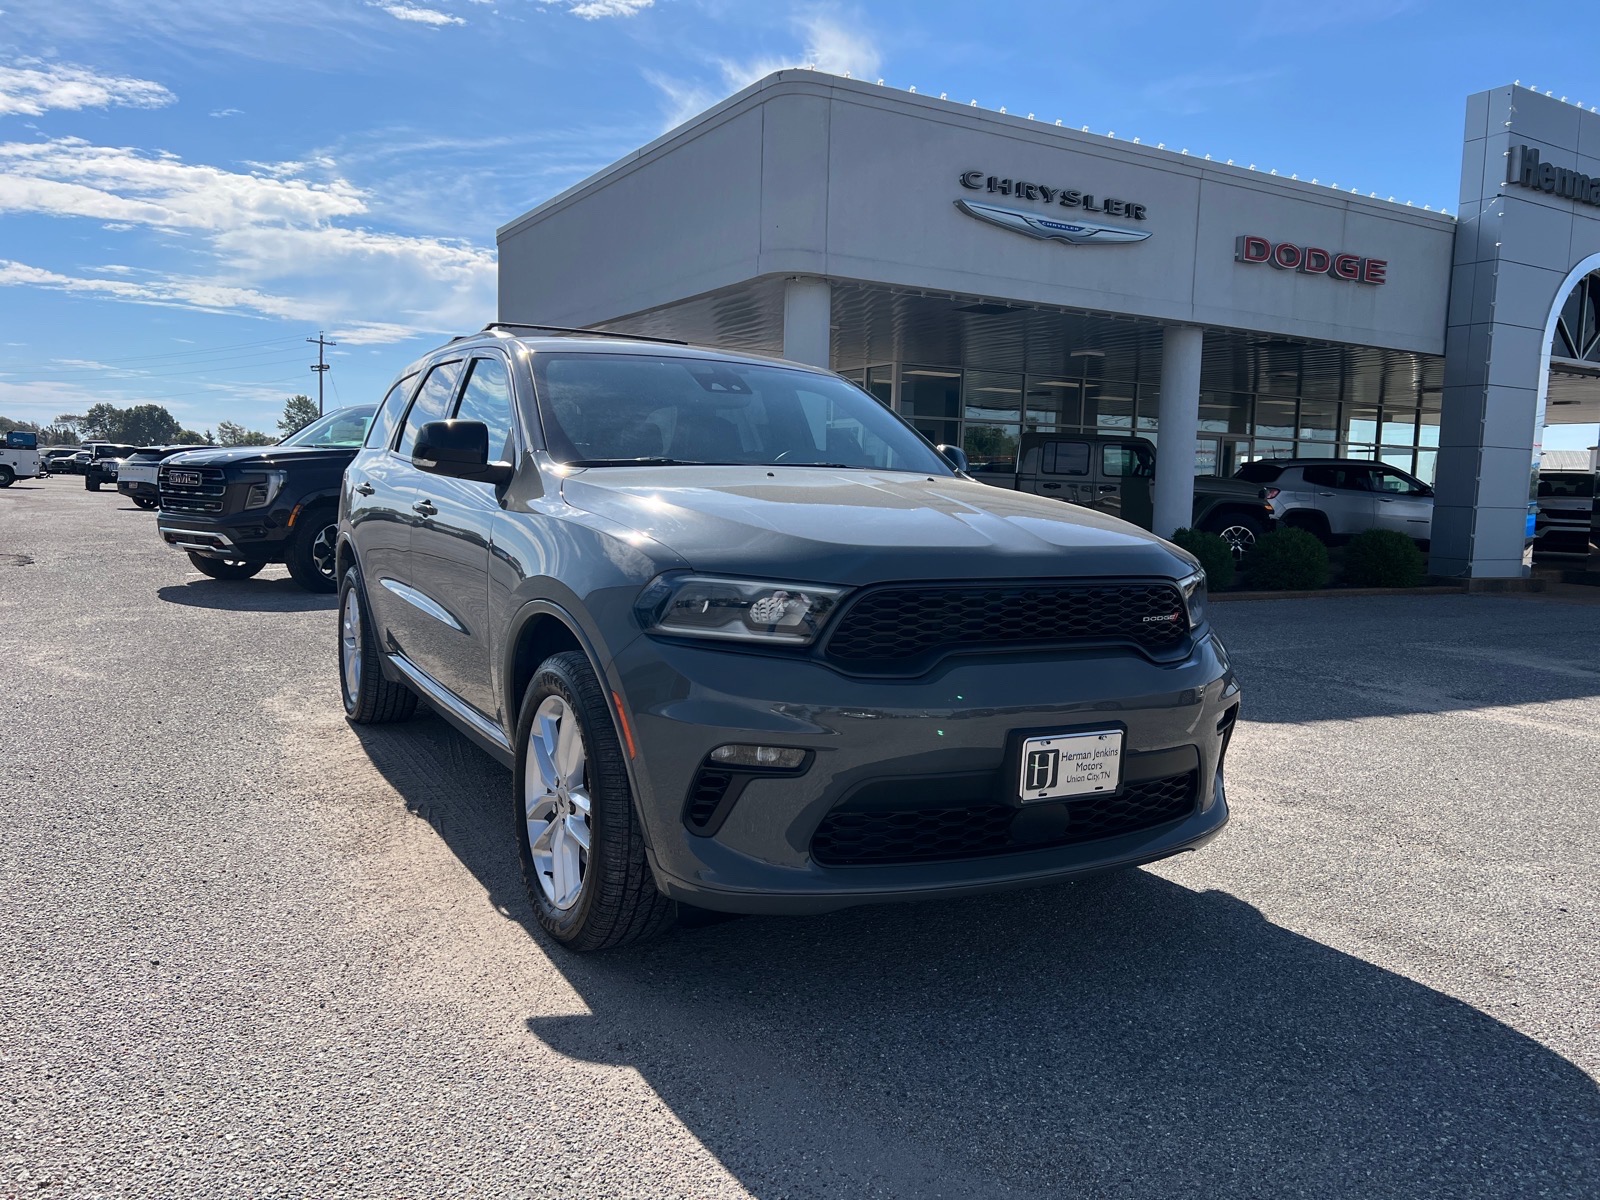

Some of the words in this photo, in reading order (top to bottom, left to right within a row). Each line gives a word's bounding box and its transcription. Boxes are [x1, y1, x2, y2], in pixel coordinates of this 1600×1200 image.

[959, 170, 1148, 220] CHRYSLER
[1041, 221, 1079, 231] CHRYSLER
[1235, 234, 1388, 285] DODGE
[170, 473, 198, 485] GMC
[1142, 614, 1175, 622] DODGE
[1061, 750, 1091, 761] Herman
[1092, 748, 1118, 760] Jenkins
[1075, 762, 1103, 772] Motors
[1066, 775, 1085, 783] Union
